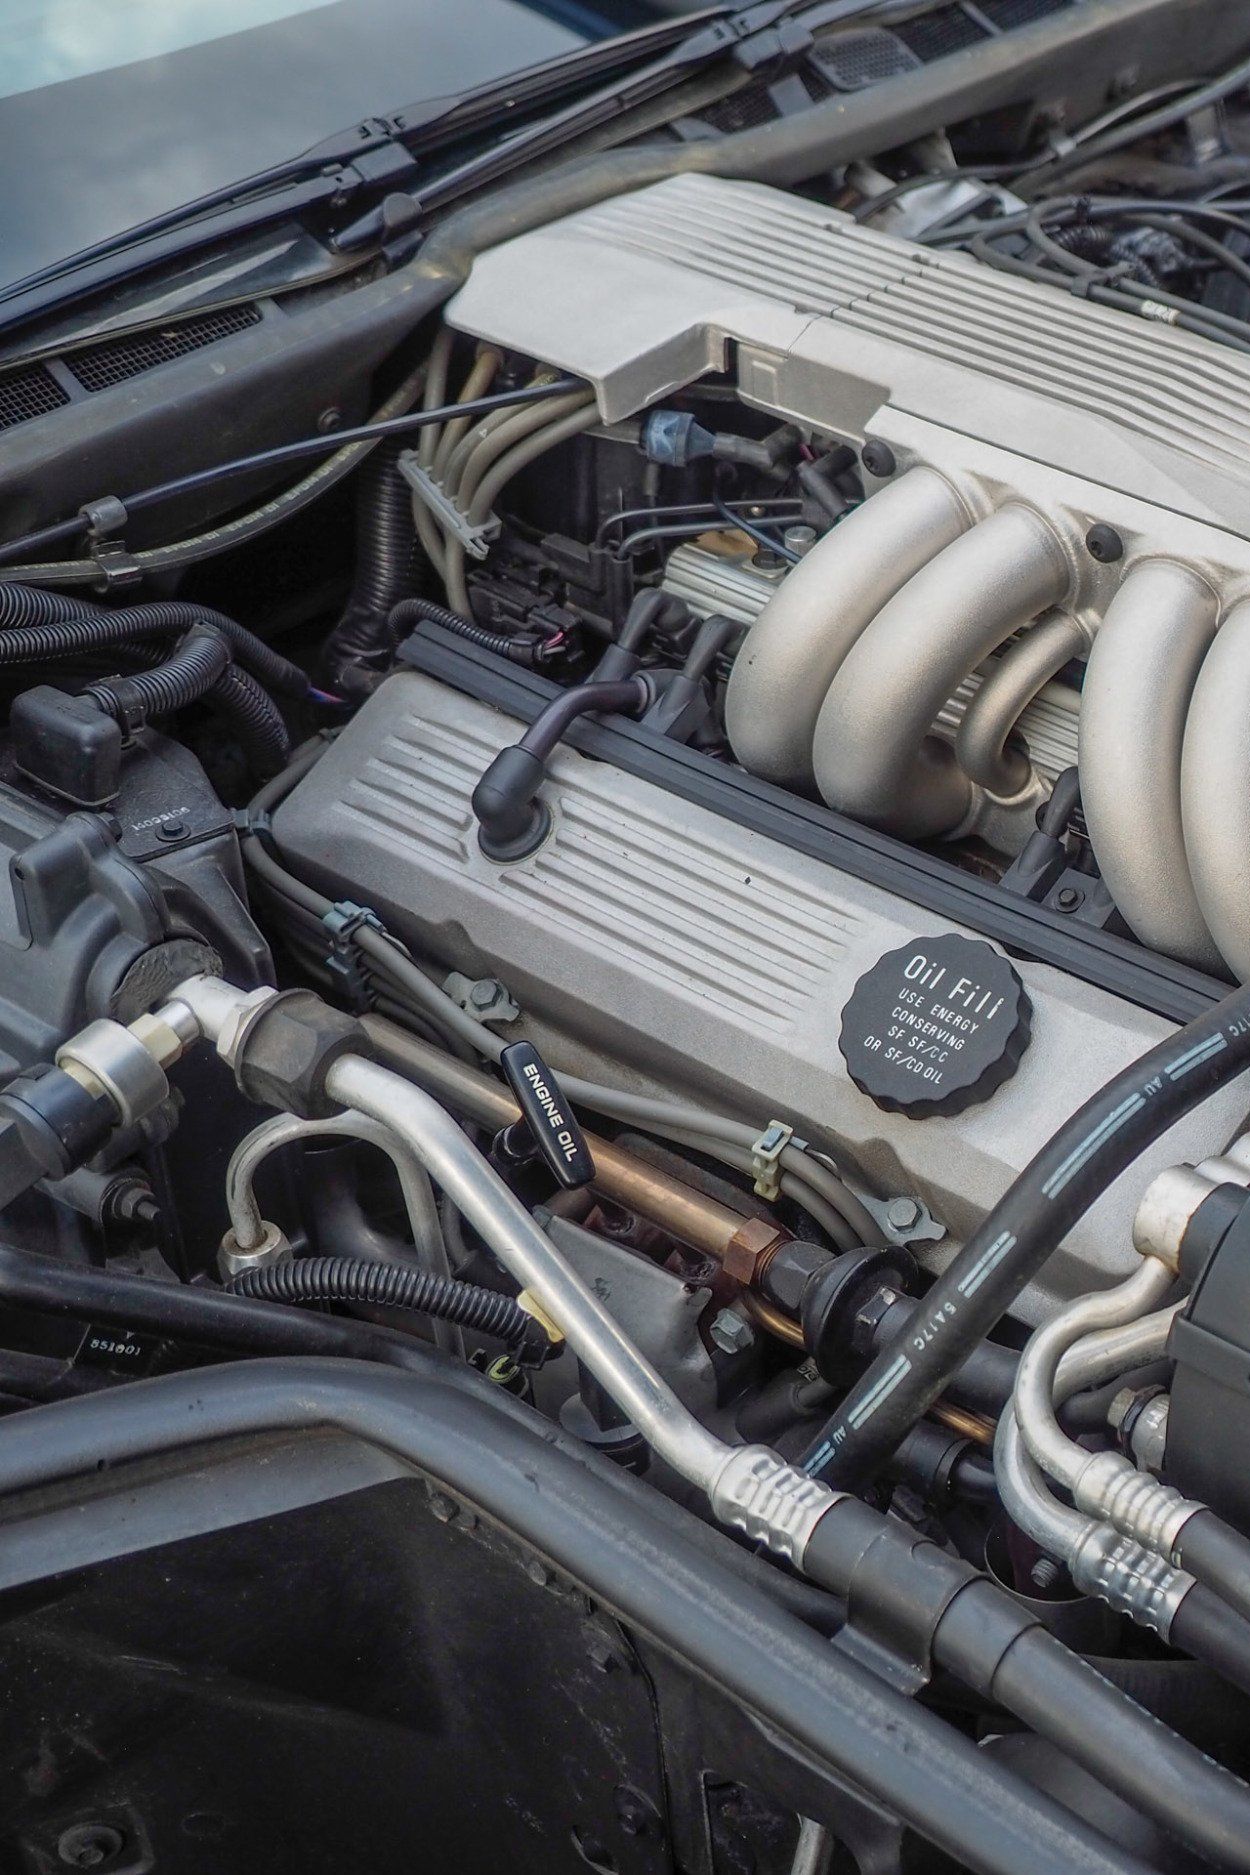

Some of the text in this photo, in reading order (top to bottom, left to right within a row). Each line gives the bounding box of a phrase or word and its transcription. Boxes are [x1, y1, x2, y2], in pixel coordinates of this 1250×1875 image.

[898, 987, 980, 1034] USE ENERGY
[904, 955, 1005, 1020] Oil Fill
[891, 1006, 966, 1051] CONSERVING
[908, 1036, 949, 1064] SF/CC
[863, 1035, 944, 1085] OR SF/CD OIL
[523, 1063, 579, 1163] ENGINE OIL
[913, 1302, 957, 1350] 5A17C
